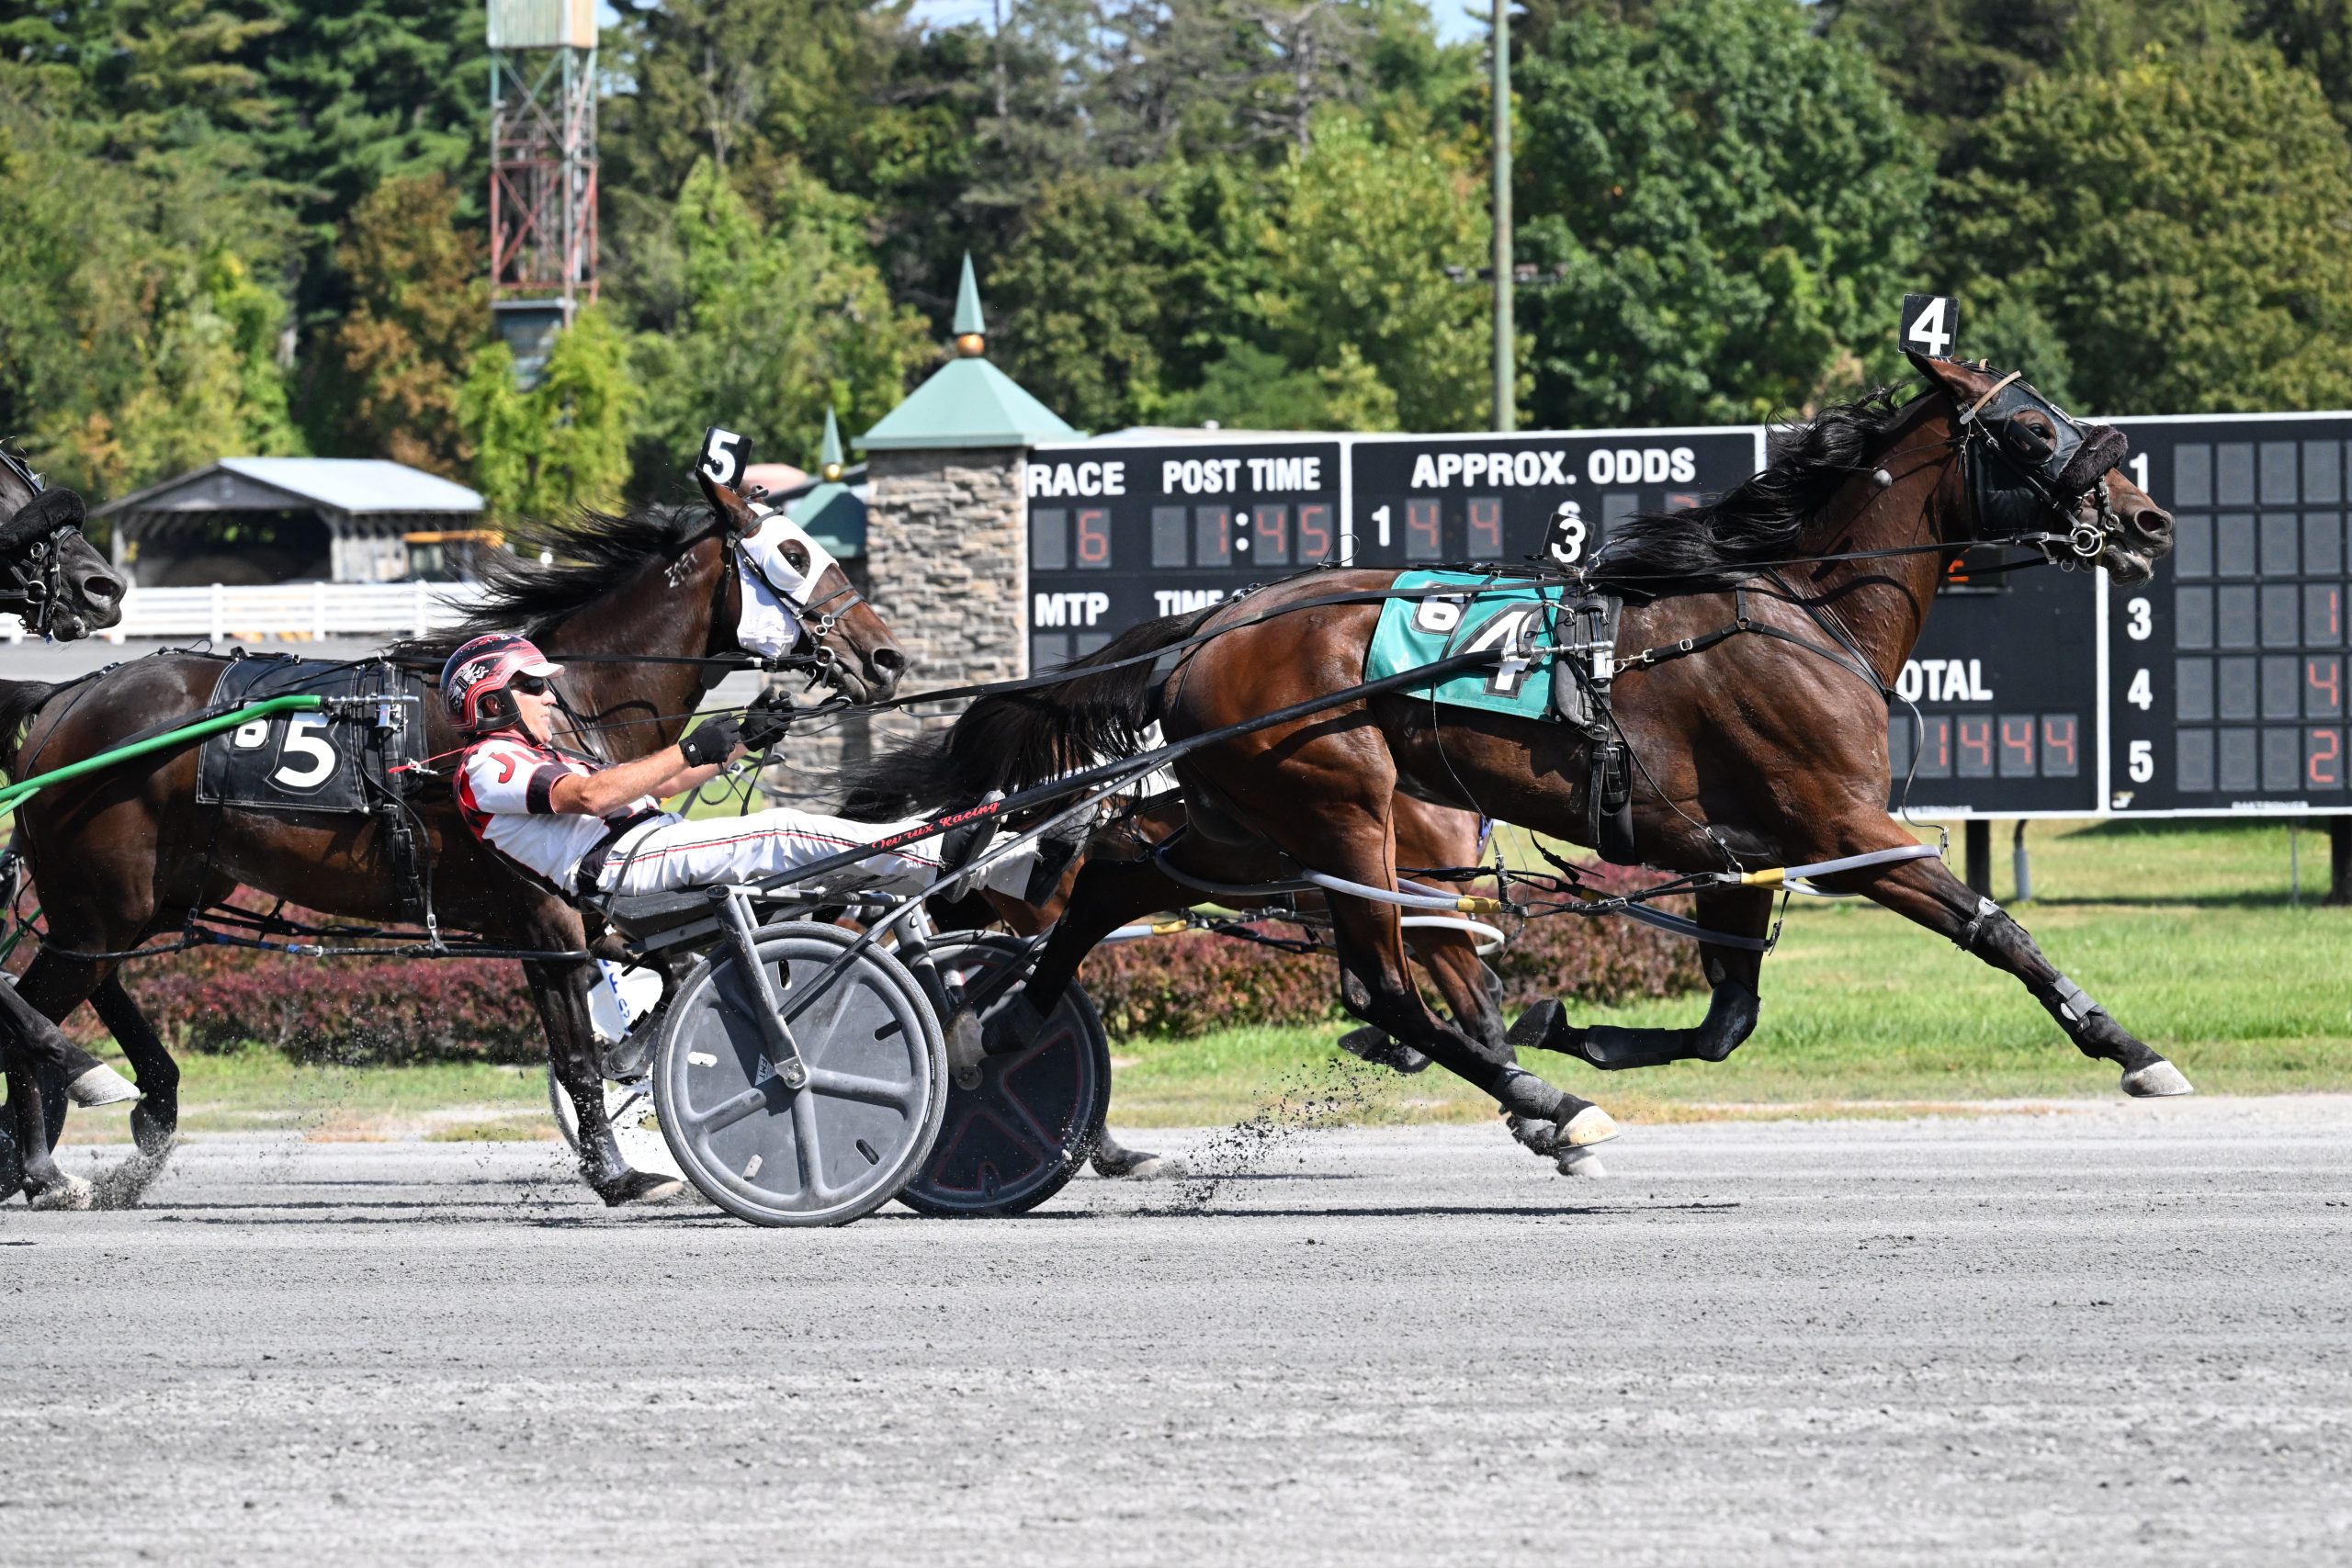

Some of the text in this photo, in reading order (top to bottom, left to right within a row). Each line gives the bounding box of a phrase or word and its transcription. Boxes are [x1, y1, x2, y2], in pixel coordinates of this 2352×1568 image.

[1908, 298, 1951, 355] 4
[703, 428, 741, 484] 5
[1162, 457, 1322, 494] POST TIME
[1410, 447, 1696, 488] APPROX. ODDS
[2129, 452, 2149, 494] 1
[1027, 461, 1125, 497] RACE
[1078, 510, 1108, 561] 6
[1371, 504, 1391, 547] 1
[1551, 517, 1587, 563] 3
[1035, 592, 1110, 627] MTP
[2127, 597, 2153, 640] 3
[2330, 591, 2338, 636] 1
[1464, 611, 1533, 691] 4
[2127, 668, 2154, 710] 4
[2308, 661, 2338, 706] 4
[274, 712, 336, 788] 5
[1939, 721, 2075, 767] 1444
[2129, 740, 2154, 783] 5
[2309, 729, 2338, 783] 2
[939, 801, 1001, 827] Racing
